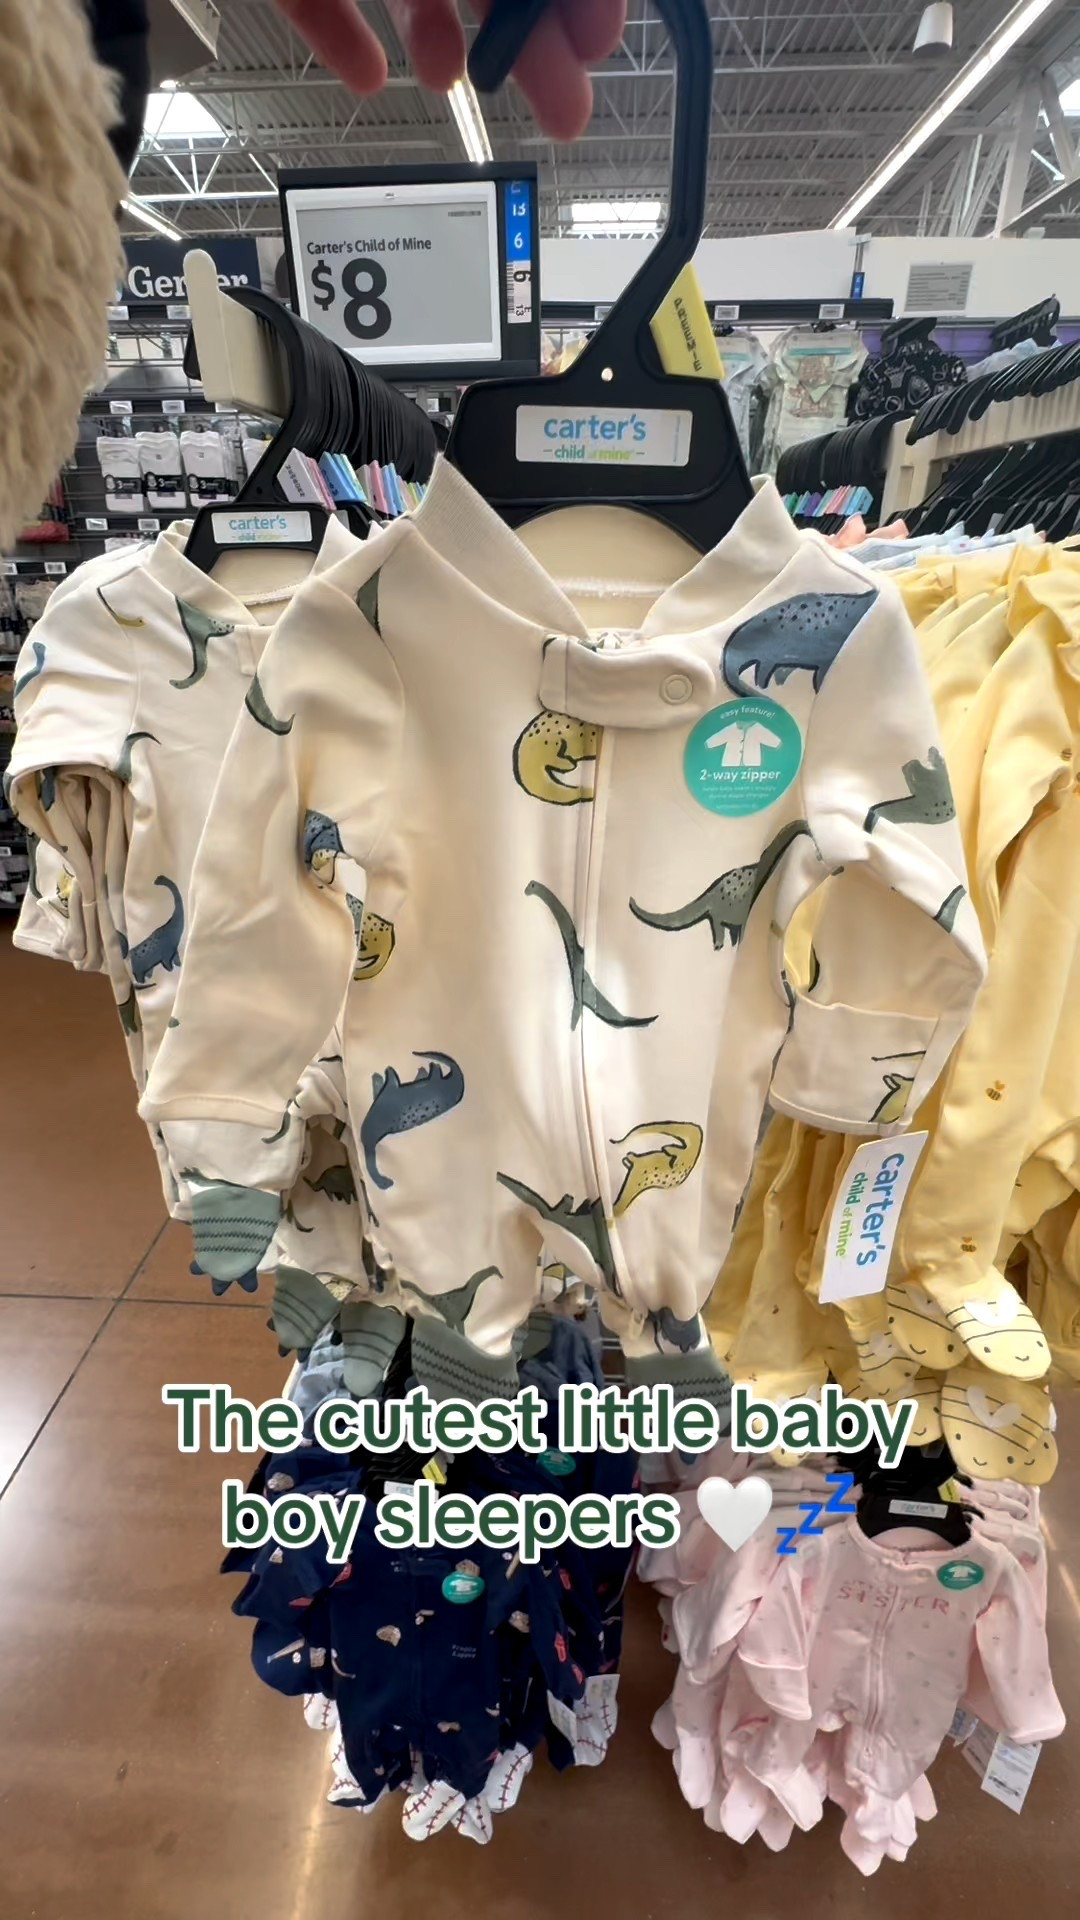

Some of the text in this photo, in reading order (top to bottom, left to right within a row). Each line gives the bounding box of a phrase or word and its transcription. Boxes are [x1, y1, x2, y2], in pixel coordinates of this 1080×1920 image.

[306, 237, 432, 255] Carter's Child of Mine
[513, 232, 524, 249] 6
[127, 265, 249, 298] Gerer
[311, 257, 392, 340] $8
[543, 413, 647, 441] carter's
[554, 445, 585, 459] child
[228, 514, 287, 530] carter's
[719, 705, 776, 720] easy feature!
[699, 768, 781, 783] 2-way zipper
[835, 1171, 868, 1257] child of mine
[856, 1152, 905, 1266] carter's
